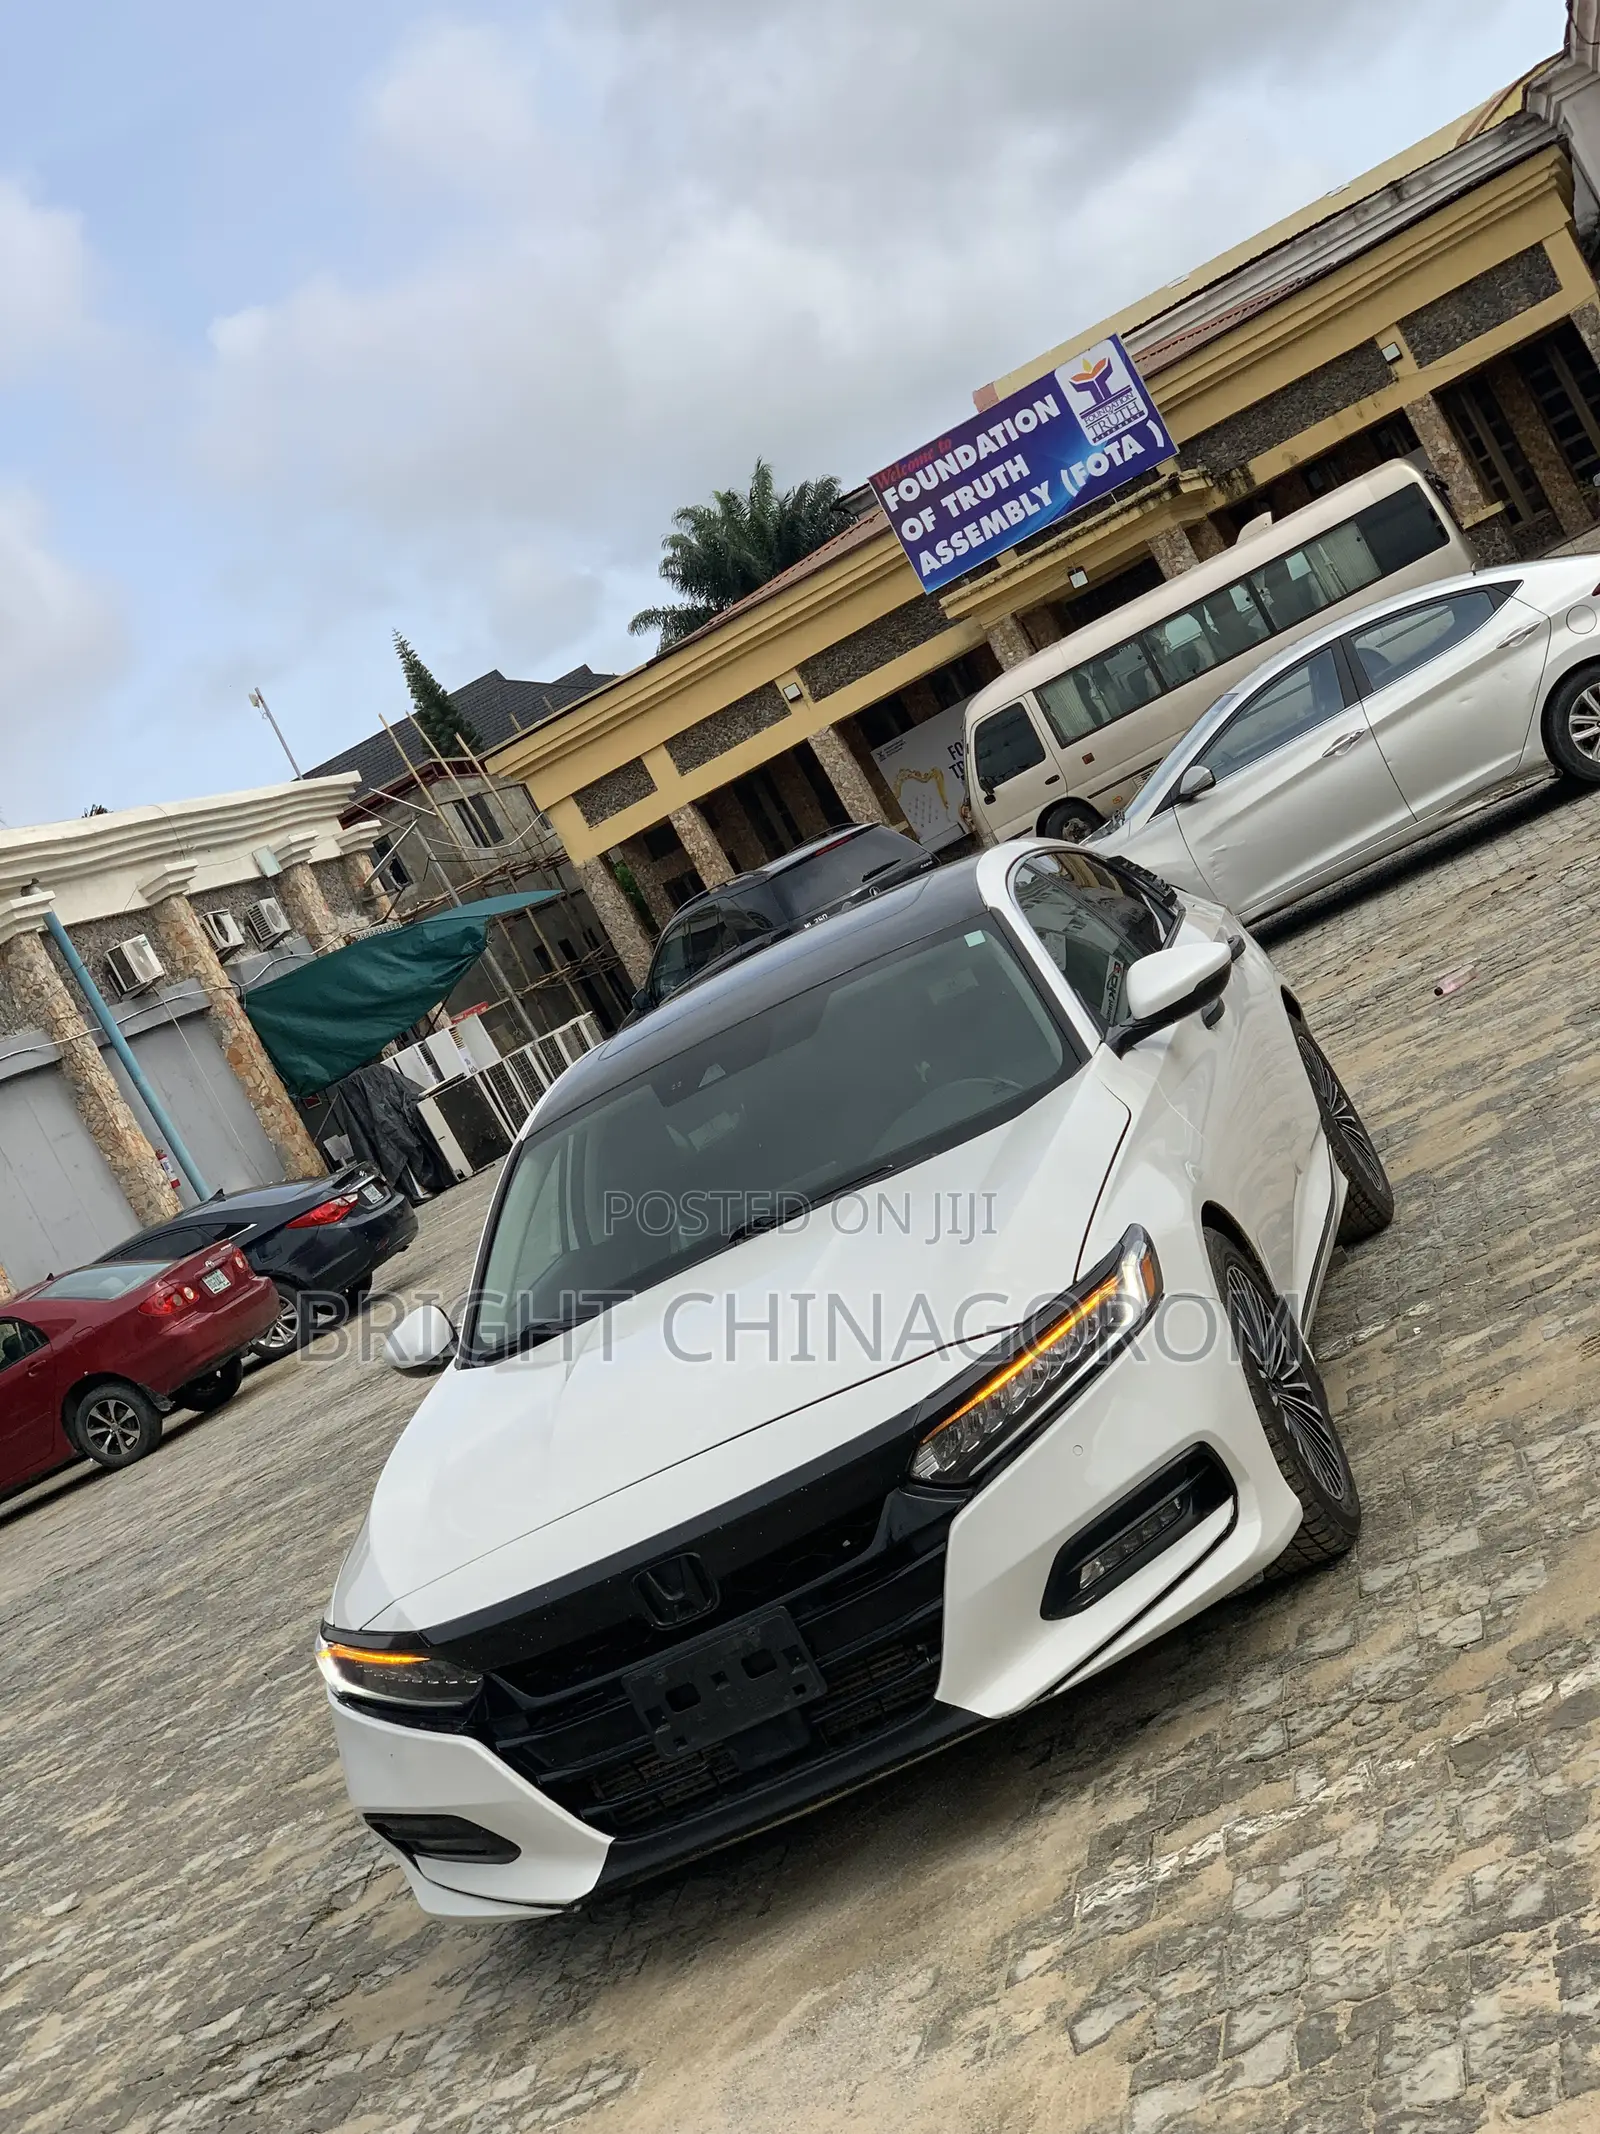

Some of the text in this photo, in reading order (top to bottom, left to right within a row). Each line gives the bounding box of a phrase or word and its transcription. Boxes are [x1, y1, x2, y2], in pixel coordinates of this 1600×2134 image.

[1083, 391, 1134, 425] FOUNDATION
[1087, 401, 1141, 439] TRUTH
[873, 438, 952, 489] Welcome to
[881, 393, 1062, 513] FOUNDATION
[901, 453, 1031, 542] OF TRUTH
[918, 480, 1053, 577] ASSEMBLY
[1060, 433, 1146, 498] (FOTA
